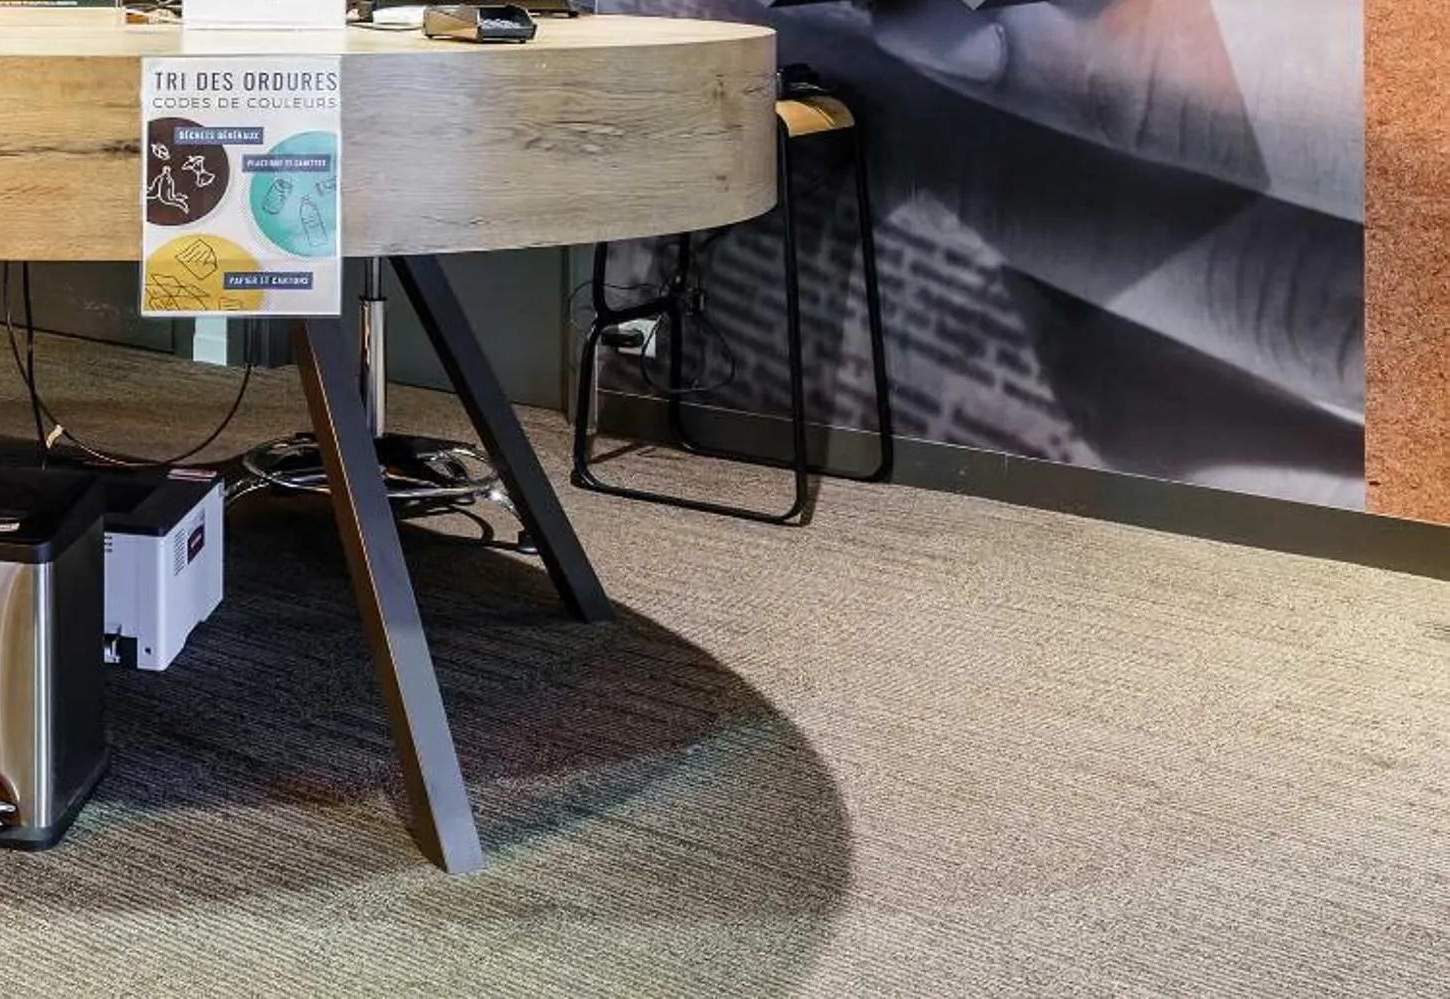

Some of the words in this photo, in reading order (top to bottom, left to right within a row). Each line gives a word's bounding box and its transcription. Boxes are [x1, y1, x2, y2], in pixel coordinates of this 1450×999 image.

[153, 72, 186, 92] TRI
[196, 72, 234, 92] DES
[243, 72, 338, 92] ORDURES
[152, 97, 211, 109] CODES
[218, 97, 239, 109] DE
[246, 97, 338, 109] COULEURS
